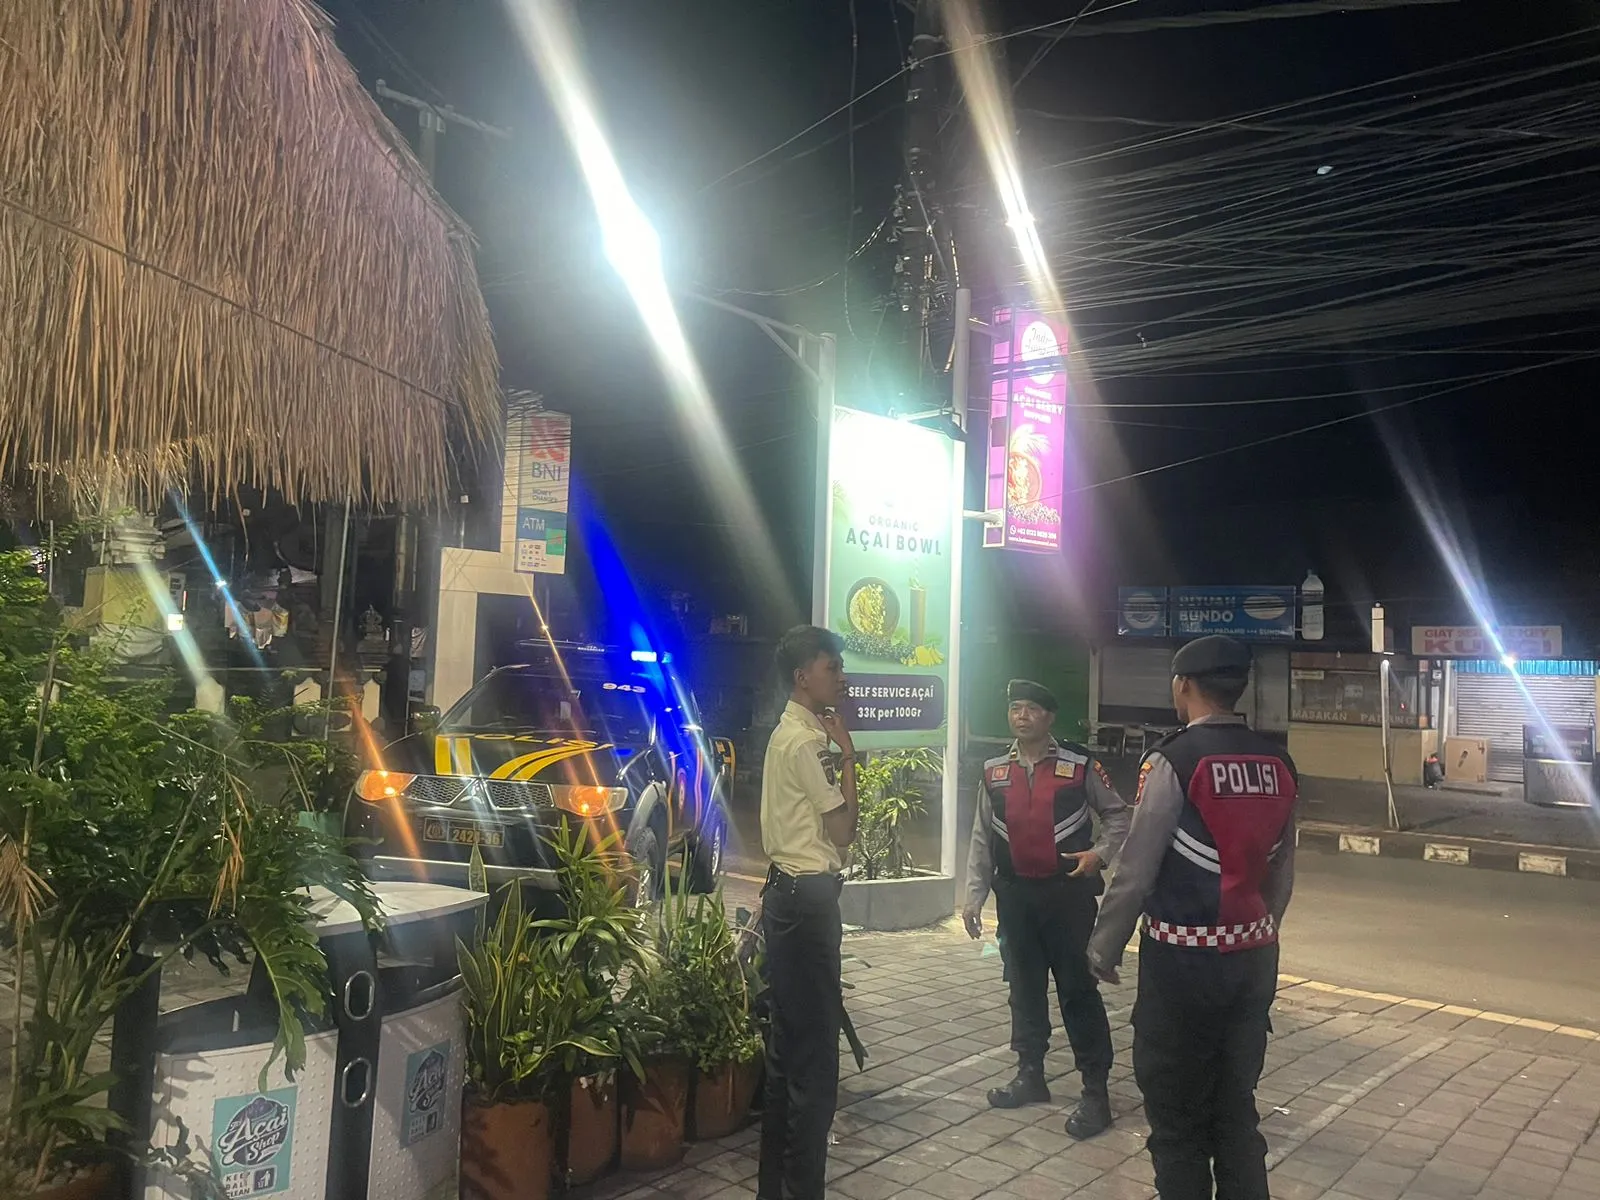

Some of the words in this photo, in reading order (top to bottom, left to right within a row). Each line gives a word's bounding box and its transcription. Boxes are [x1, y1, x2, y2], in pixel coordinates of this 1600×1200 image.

[532, 462, 561, 481] BNI
[523, 516, 545, 532] ATM
[868, 514, 919, 532] ORGANIC
[846, 527, 890, 552] AÇAI
[896, 534, 941, 556] BOWL
[1180, 610, 1234, 622] BUNDO
[603, 682, 646, 693] 943
[848, 686, 870, 698] SELF
[872, 687, 910, 698] SERVICE
[857, 707, 876, 719] 33K
[878, 709, 894, 721] per
[895, 707, 921, 717] 100Gr
[1360, 713, 1417, 724] PAANG
[1212, 762, 1279, 795] POLISI
[246, 1132, 281, 1161] Shop
